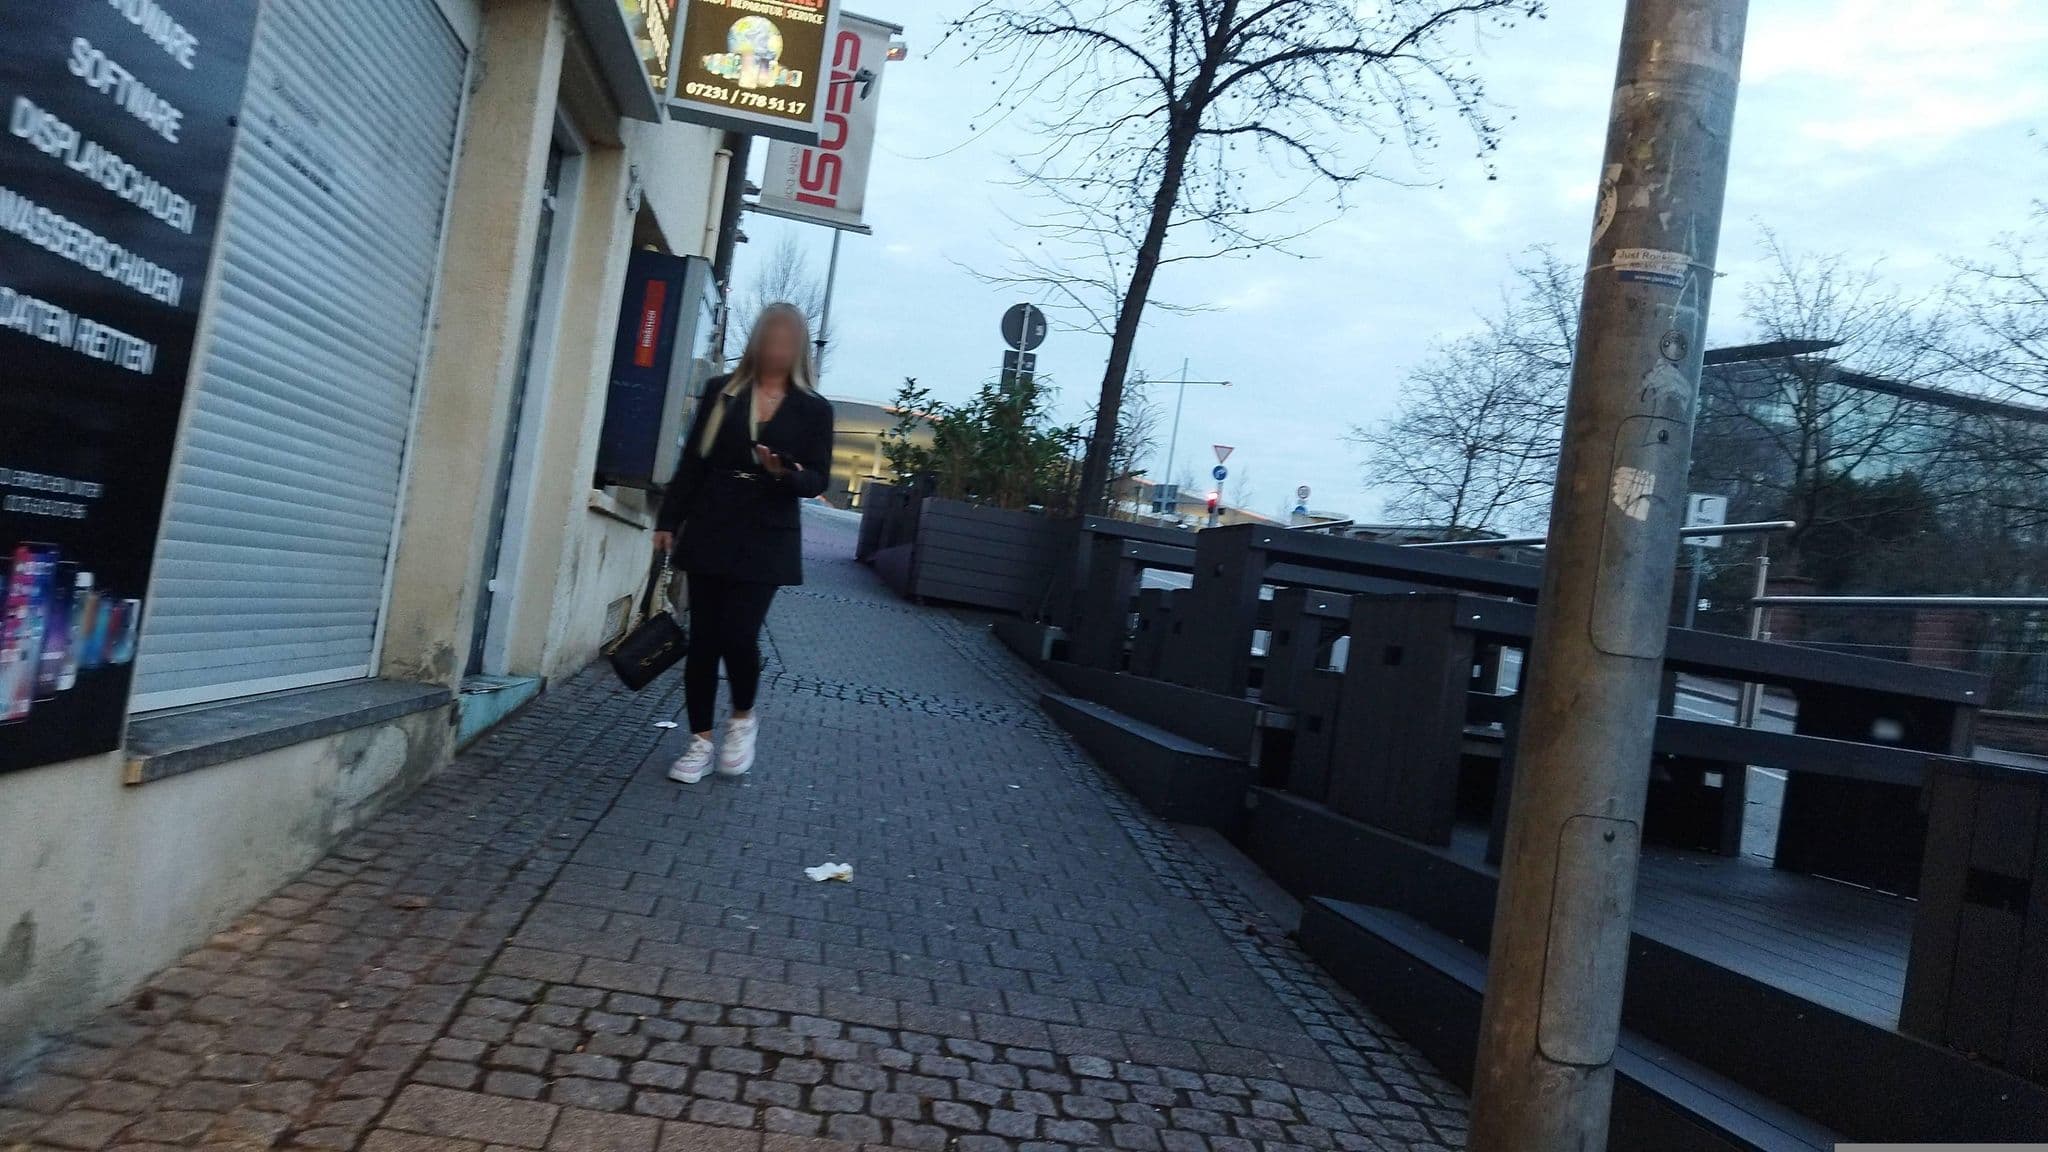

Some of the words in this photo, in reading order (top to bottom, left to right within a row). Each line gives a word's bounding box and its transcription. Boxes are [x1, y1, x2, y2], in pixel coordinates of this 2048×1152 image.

[787, 8, 825, 25] SERVICE
[67, 36, 184, 144] SOFTWARE
[686, 82, 729, 101] 07231
[787, 101, 806, 114] 17
[10, 95, 197, 235] DISPLAYSCHADEN
[0, 185, 184, 307] WASSERSCHADEN
[73, 317, 157, 375] RETTEN
